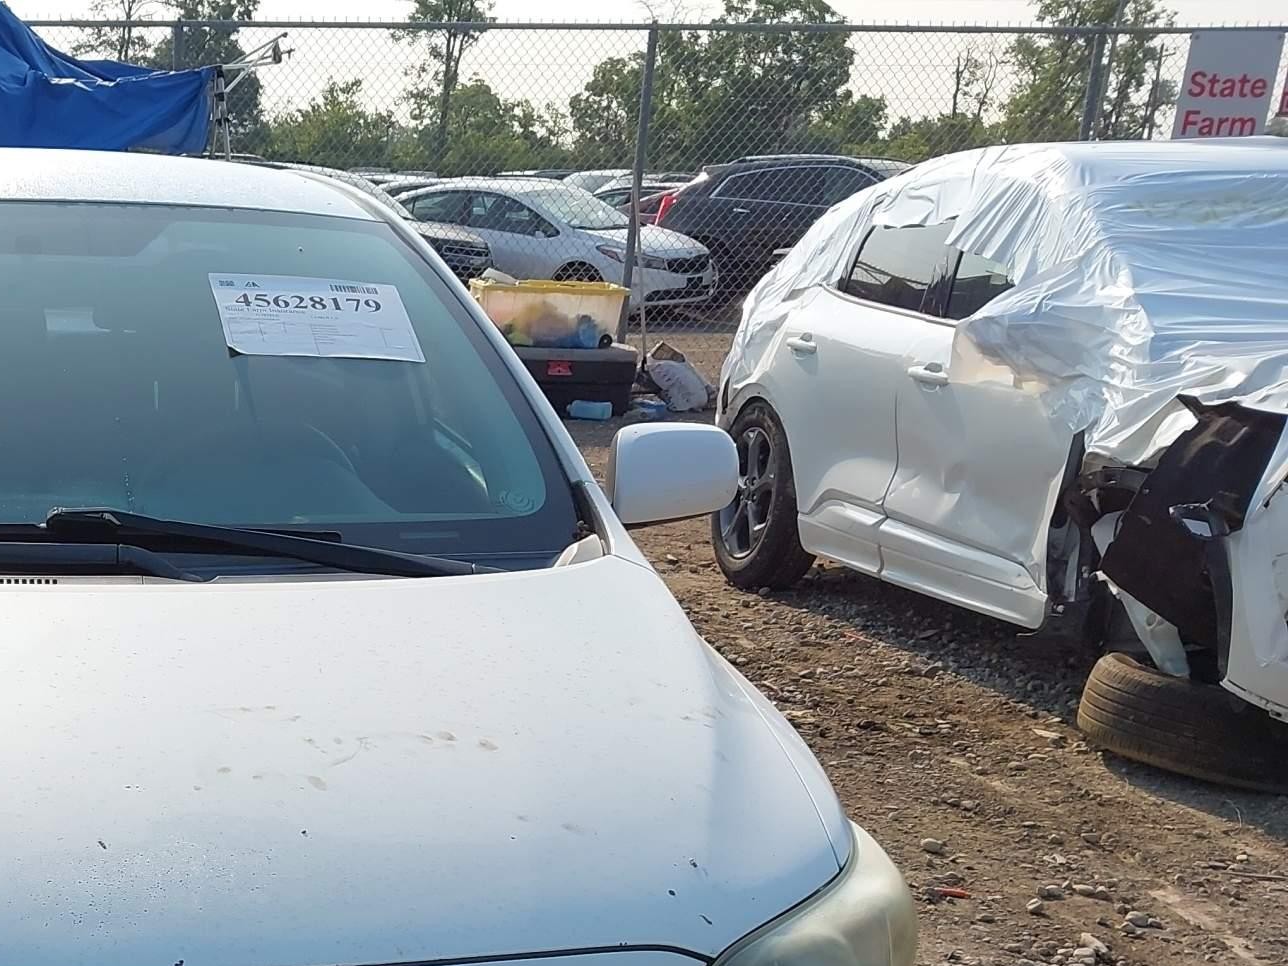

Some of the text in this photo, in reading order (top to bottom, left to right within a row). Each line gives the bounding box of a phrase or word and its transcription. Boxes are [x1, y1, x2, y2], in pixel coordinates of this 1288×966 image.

[1188, 71, 1267, 98] State
[1181, 110, 1256, 136] Farm
[235, 292, 381, 313] 45628179
